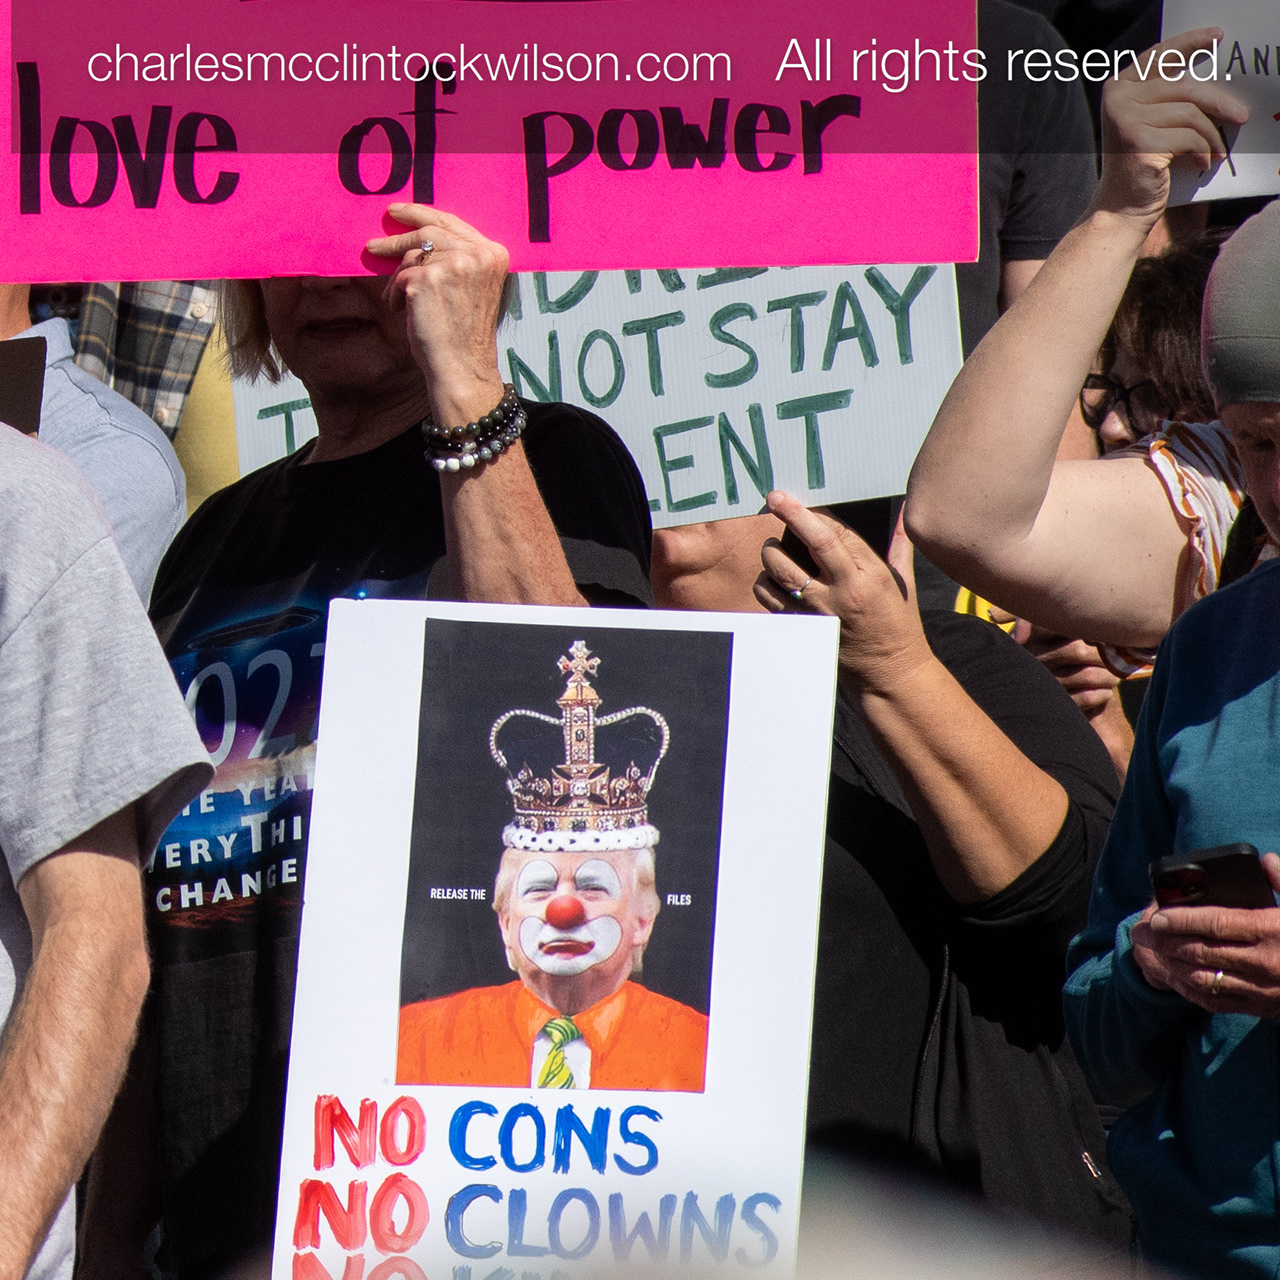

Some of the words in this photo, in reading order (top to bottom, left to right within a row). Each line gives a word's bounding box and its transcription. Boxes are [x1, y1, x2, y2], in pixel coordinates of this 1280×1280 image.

[16, 61, 240, 215] love
[337, 61, 457, 205] of
[522, 92, 862, 244] power
[506, 309, 686, 410] NOT
[704, 264, 938, 390] STAY
[648, 388, 856, 513] ENT
[430, 887, 469, 900] RELEASE
[470, 888, 486, 901] THE
[667, 894, 692, 906] FILES
[312, 1093, 428, 1172] NO
[448, 1099, 664, 1176] CONS
[292, 1172, 430, 1254] NO
[444, 1183, 783, 1268] CLOWNS
